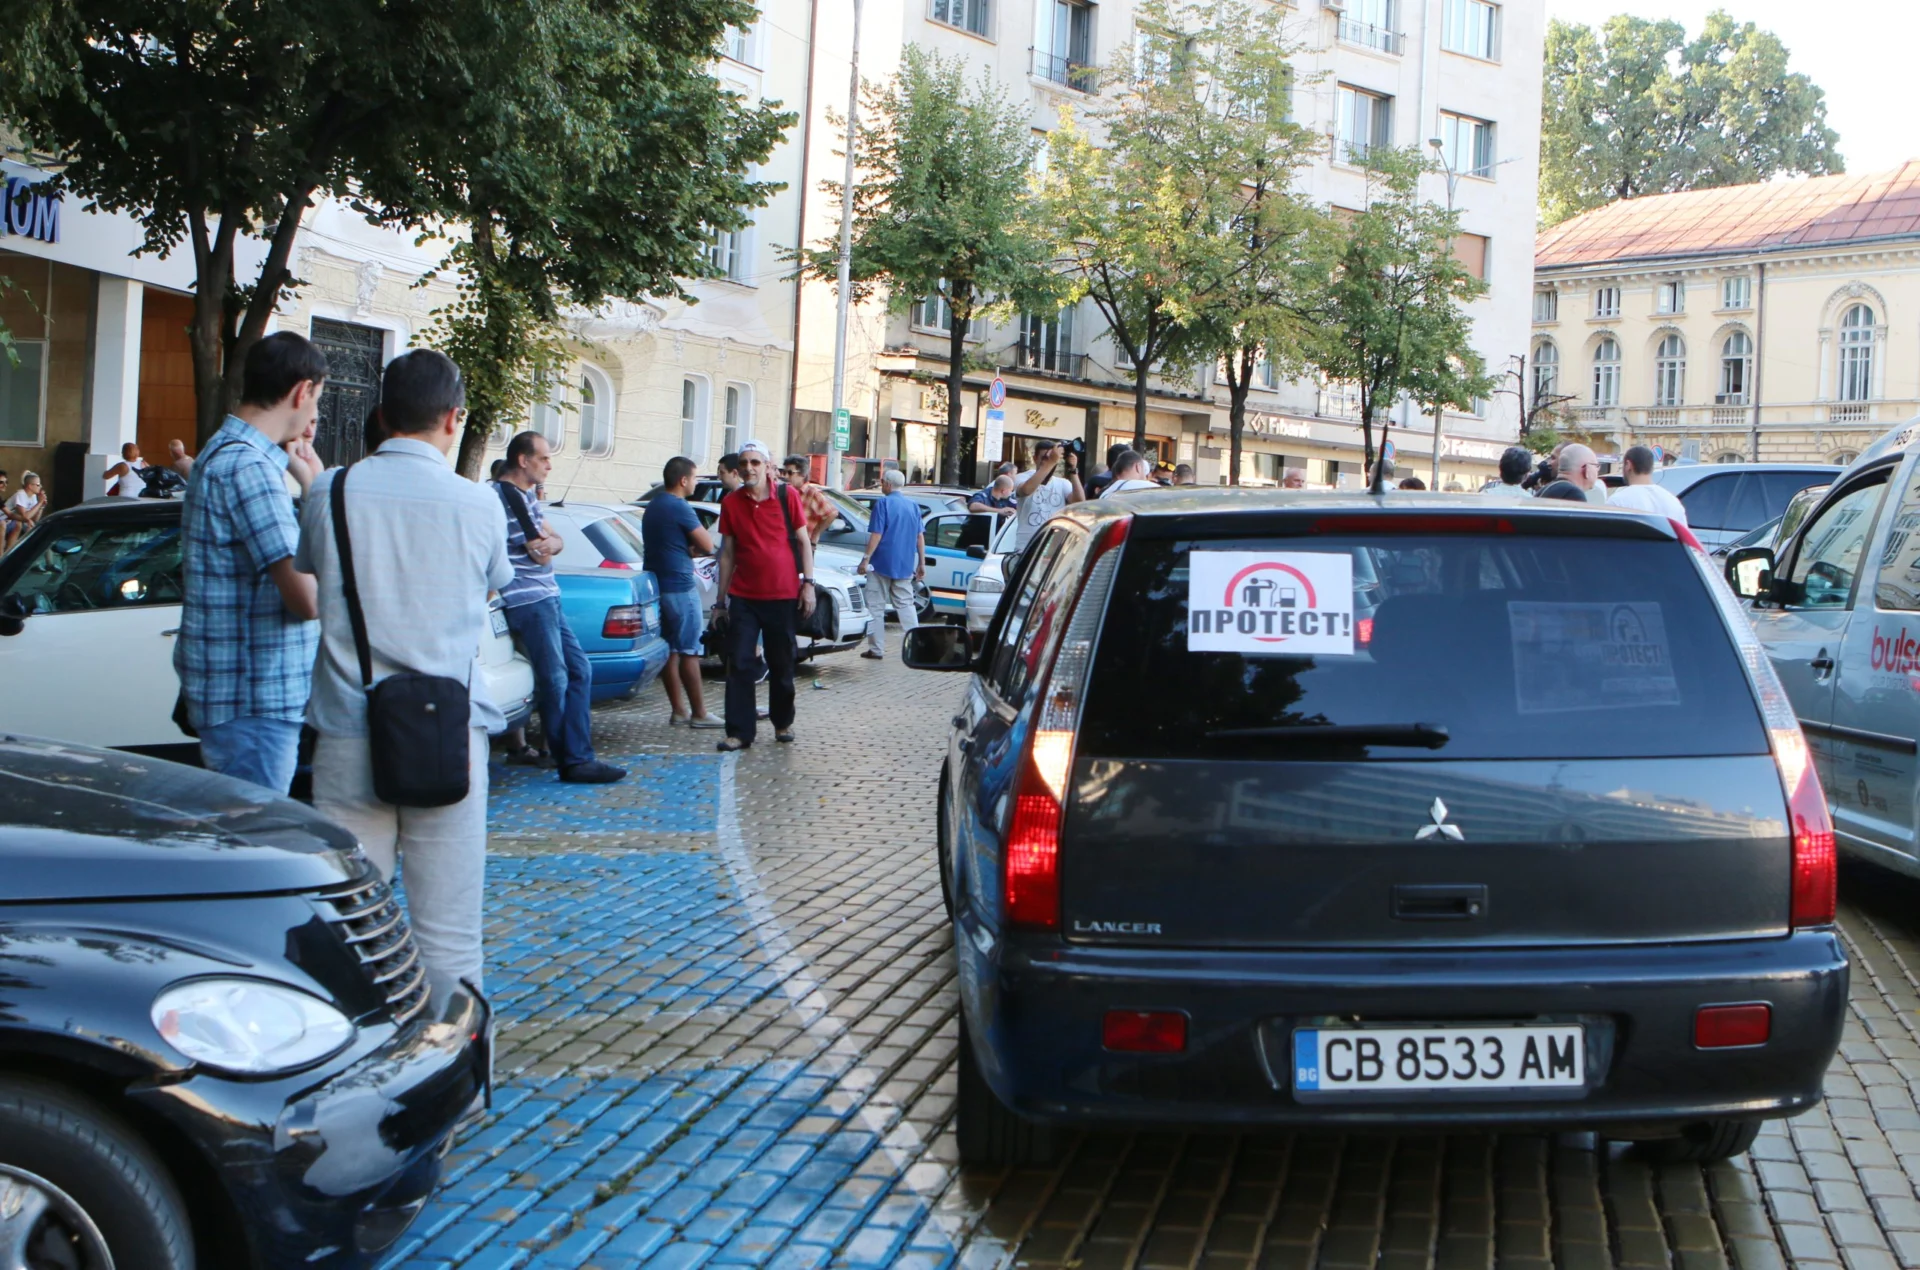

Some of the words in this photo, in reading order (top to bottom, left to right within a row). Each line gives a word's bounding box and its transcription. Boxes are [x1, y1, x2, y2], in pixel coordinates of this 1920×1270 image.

[1267, 416, 1311, 439] Fibank
[1191, 609, 1351, 637] ПРОТЕСТ!
[1073, 920, 1162, 935] LANCER
[1325, 1037, 1384, 1082] CB
[1396, 1035, 1505, 1081] 8533
[1519, 1035, 1576, 1080] AM
[1298, 1068, 1318, 1083] BG
